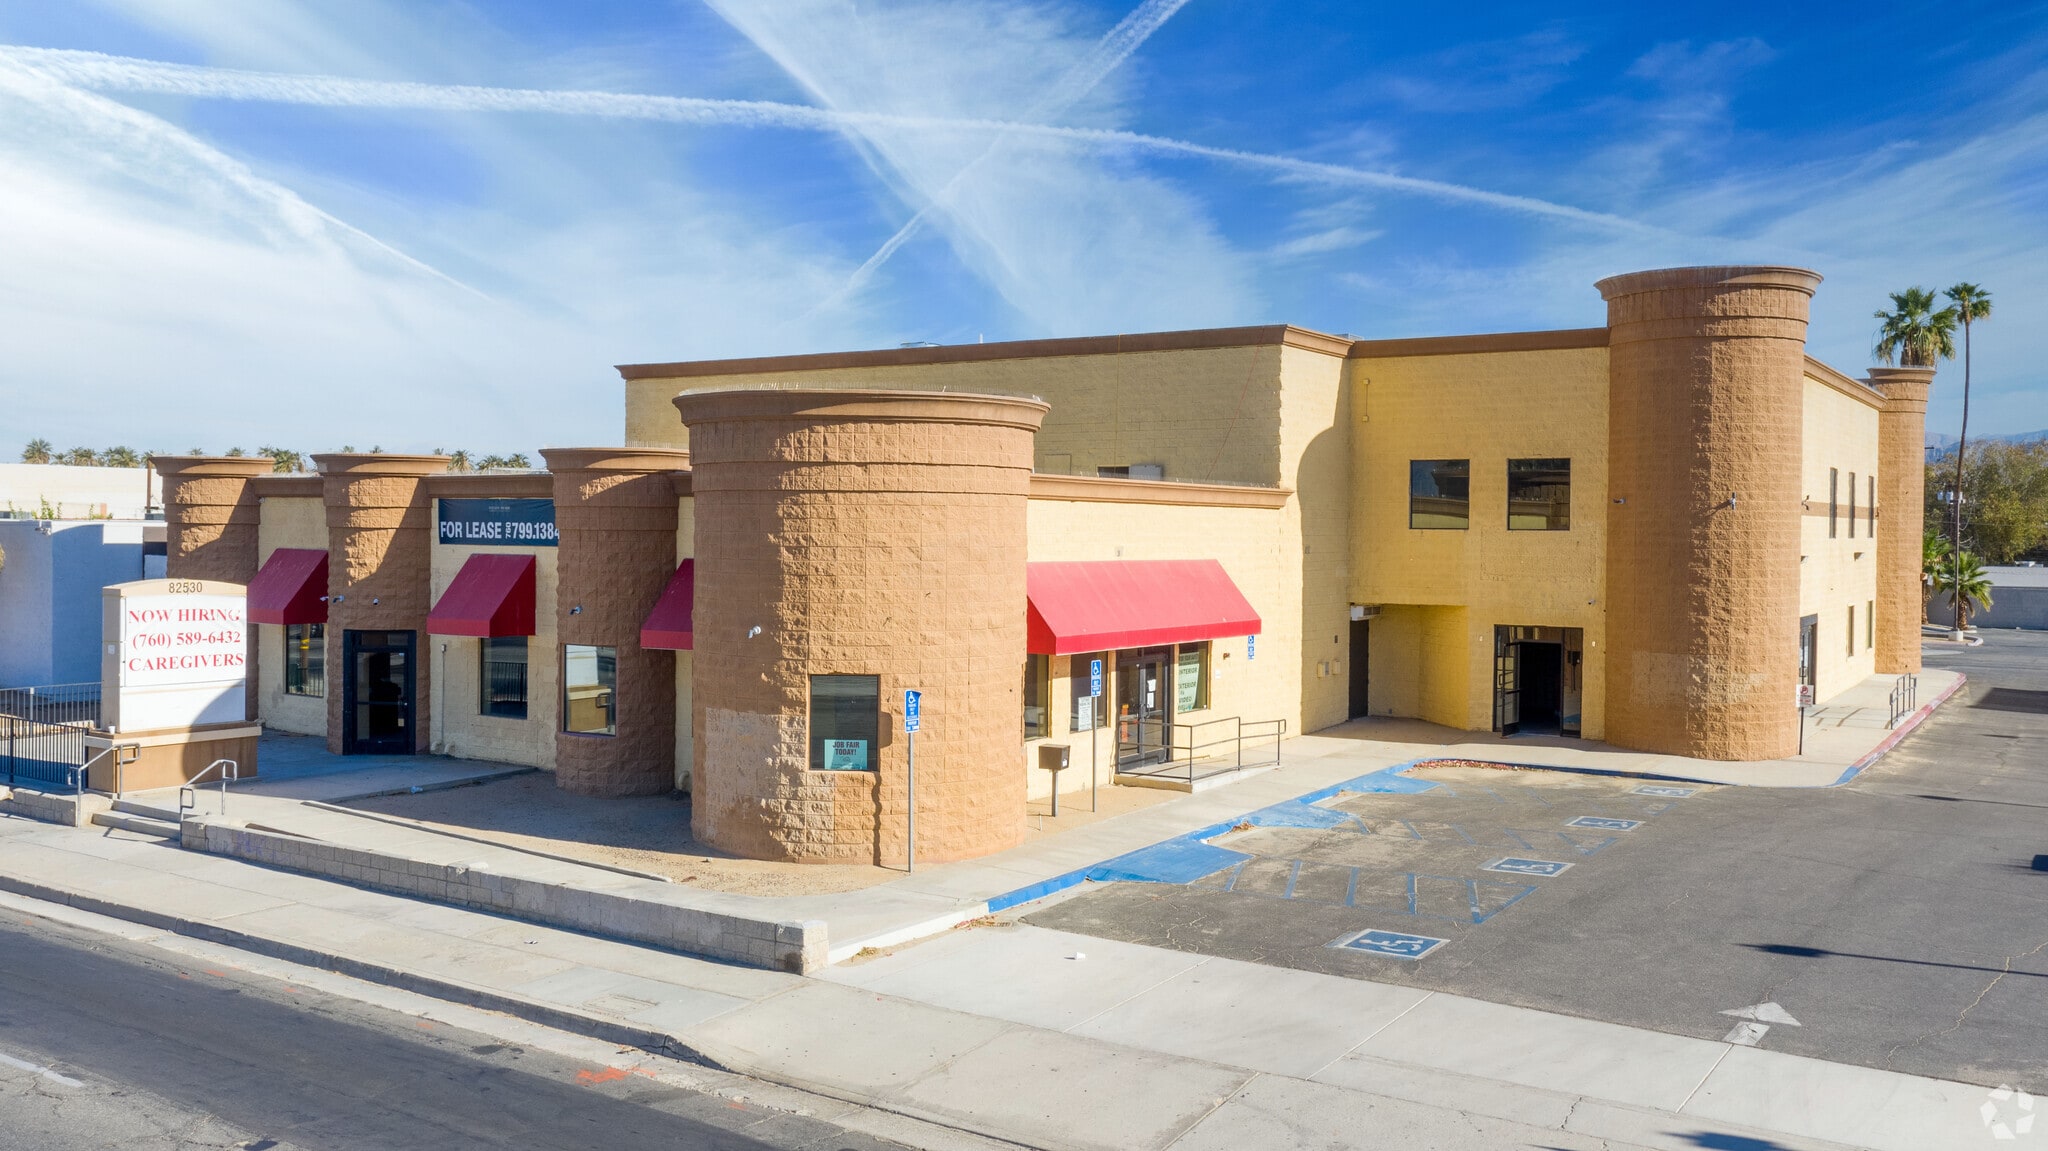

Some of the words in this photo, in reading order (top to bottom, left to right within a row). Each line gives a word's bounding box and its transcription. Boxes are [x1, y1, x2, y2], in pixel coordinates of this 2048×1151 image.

[440, 521, 463, 538] FOR
[466, 522, 502, 539] LEASE
[168, 582, 203, 594] 82530
[129, 609, 173, 624] NOW
[178, 608, 241, 622] HIRING
[132, 632, 172, 650] (760)
[176, 630, 241, 646] 589-6432
[129, 653, 244, 672] CAREGIVERS
